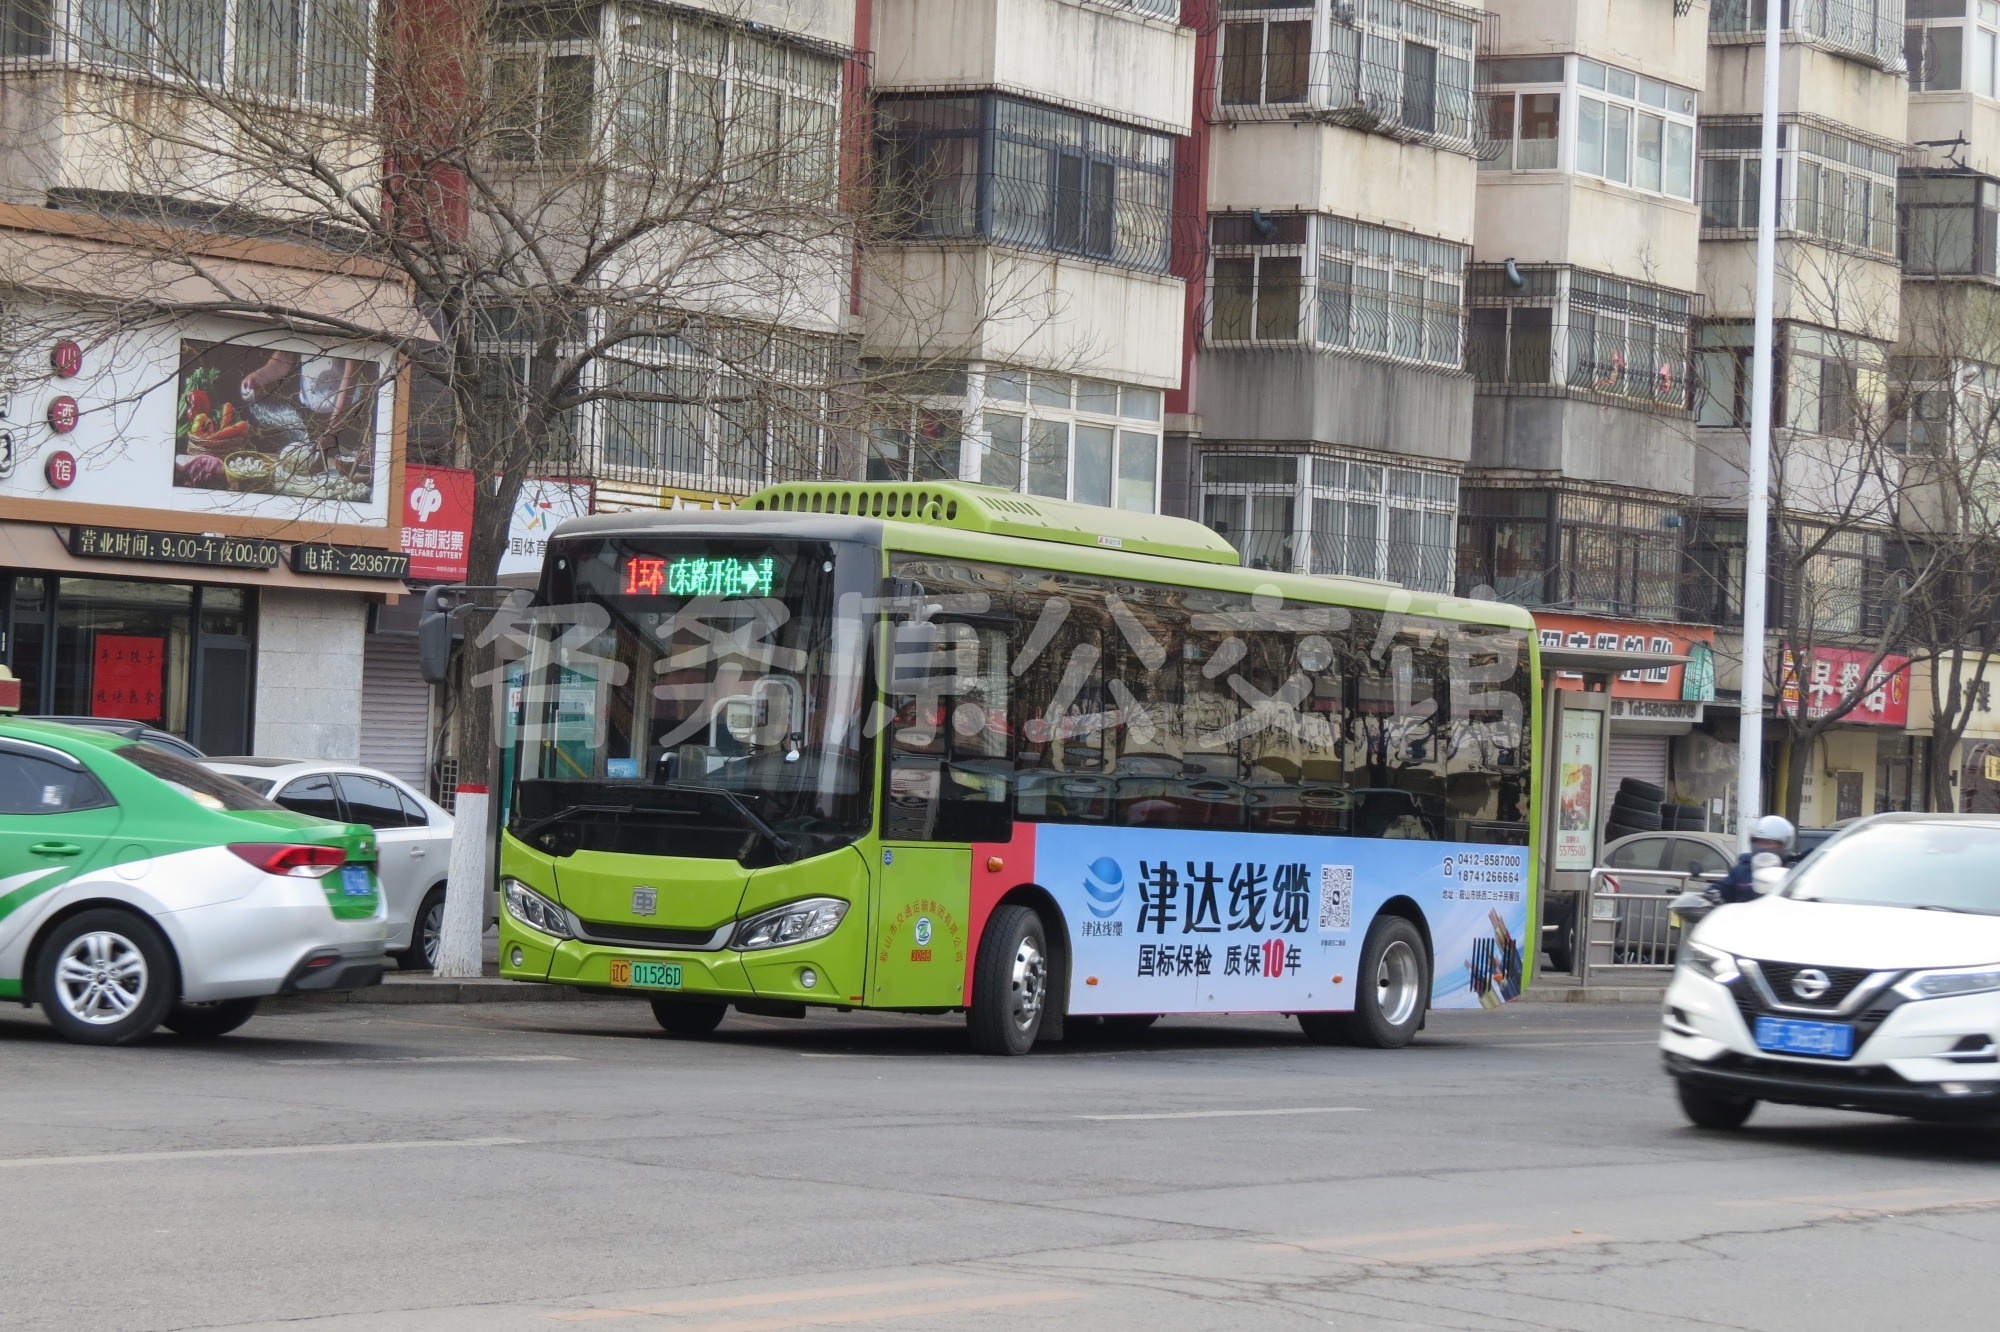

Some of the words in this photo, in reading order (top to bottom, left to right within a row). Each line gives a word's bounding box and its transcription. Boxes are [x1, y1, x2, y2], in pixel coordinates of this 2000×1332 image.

[404, 547, 434, 557] WELFARE
[435, 550, 463, 559] LOTTERY
[507, 537, 548, 557] 国体育
[1808, 660, 1890, 713] 早餐店
[1457, 853, 1520, 867] 0412-8587000
[1457, 870, 1520, 883] 18741266664
[1136, 860, 1311, 934] 津达线缆
[1081, 921, 1123, 937] 津达线缆
[1137, 944, 1212, 977] 国标保检
[1223, 939, 1302, 978] 质保10年
[612, 964, 628, 982] 辽C
[634, 964, 681, 985] 01526D
